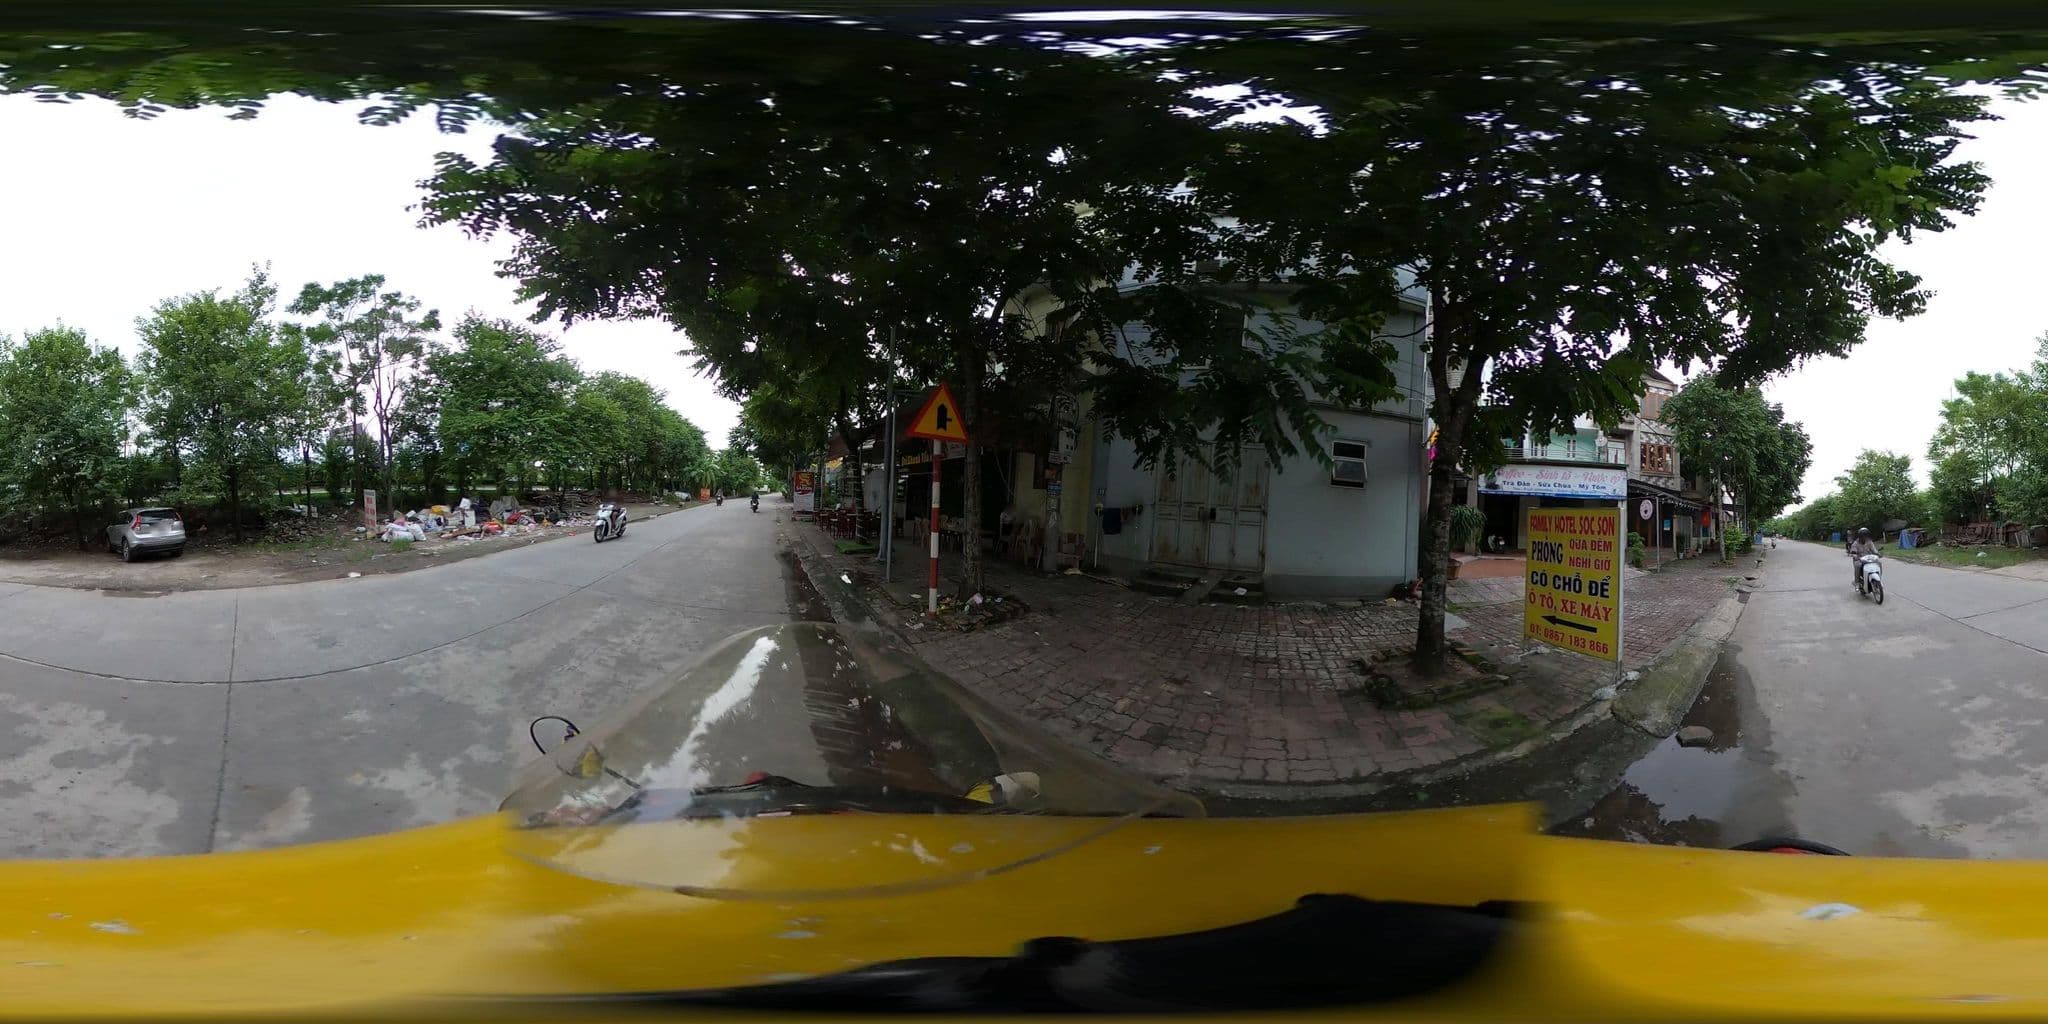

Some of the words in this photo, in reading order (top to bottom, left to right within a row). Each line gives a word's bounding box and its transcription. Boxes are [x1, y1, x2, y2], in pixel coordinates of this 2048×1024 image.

[1530, 515, 1552, 531] FAMILY
[1530, 569, 1547, 587] CÓ
[1552, 572, 1582, 594] CHỖ
[1588, 575, 1612, 599] ĐỂ
[1528, 588, 1537, 604] Ô
[1559, 598, 1578, 615] XE
[1580, 600, 1613, 622] MÁY
[1568, 634, 1586, 649] 183
[1589, 639, 1609, 655] 866
